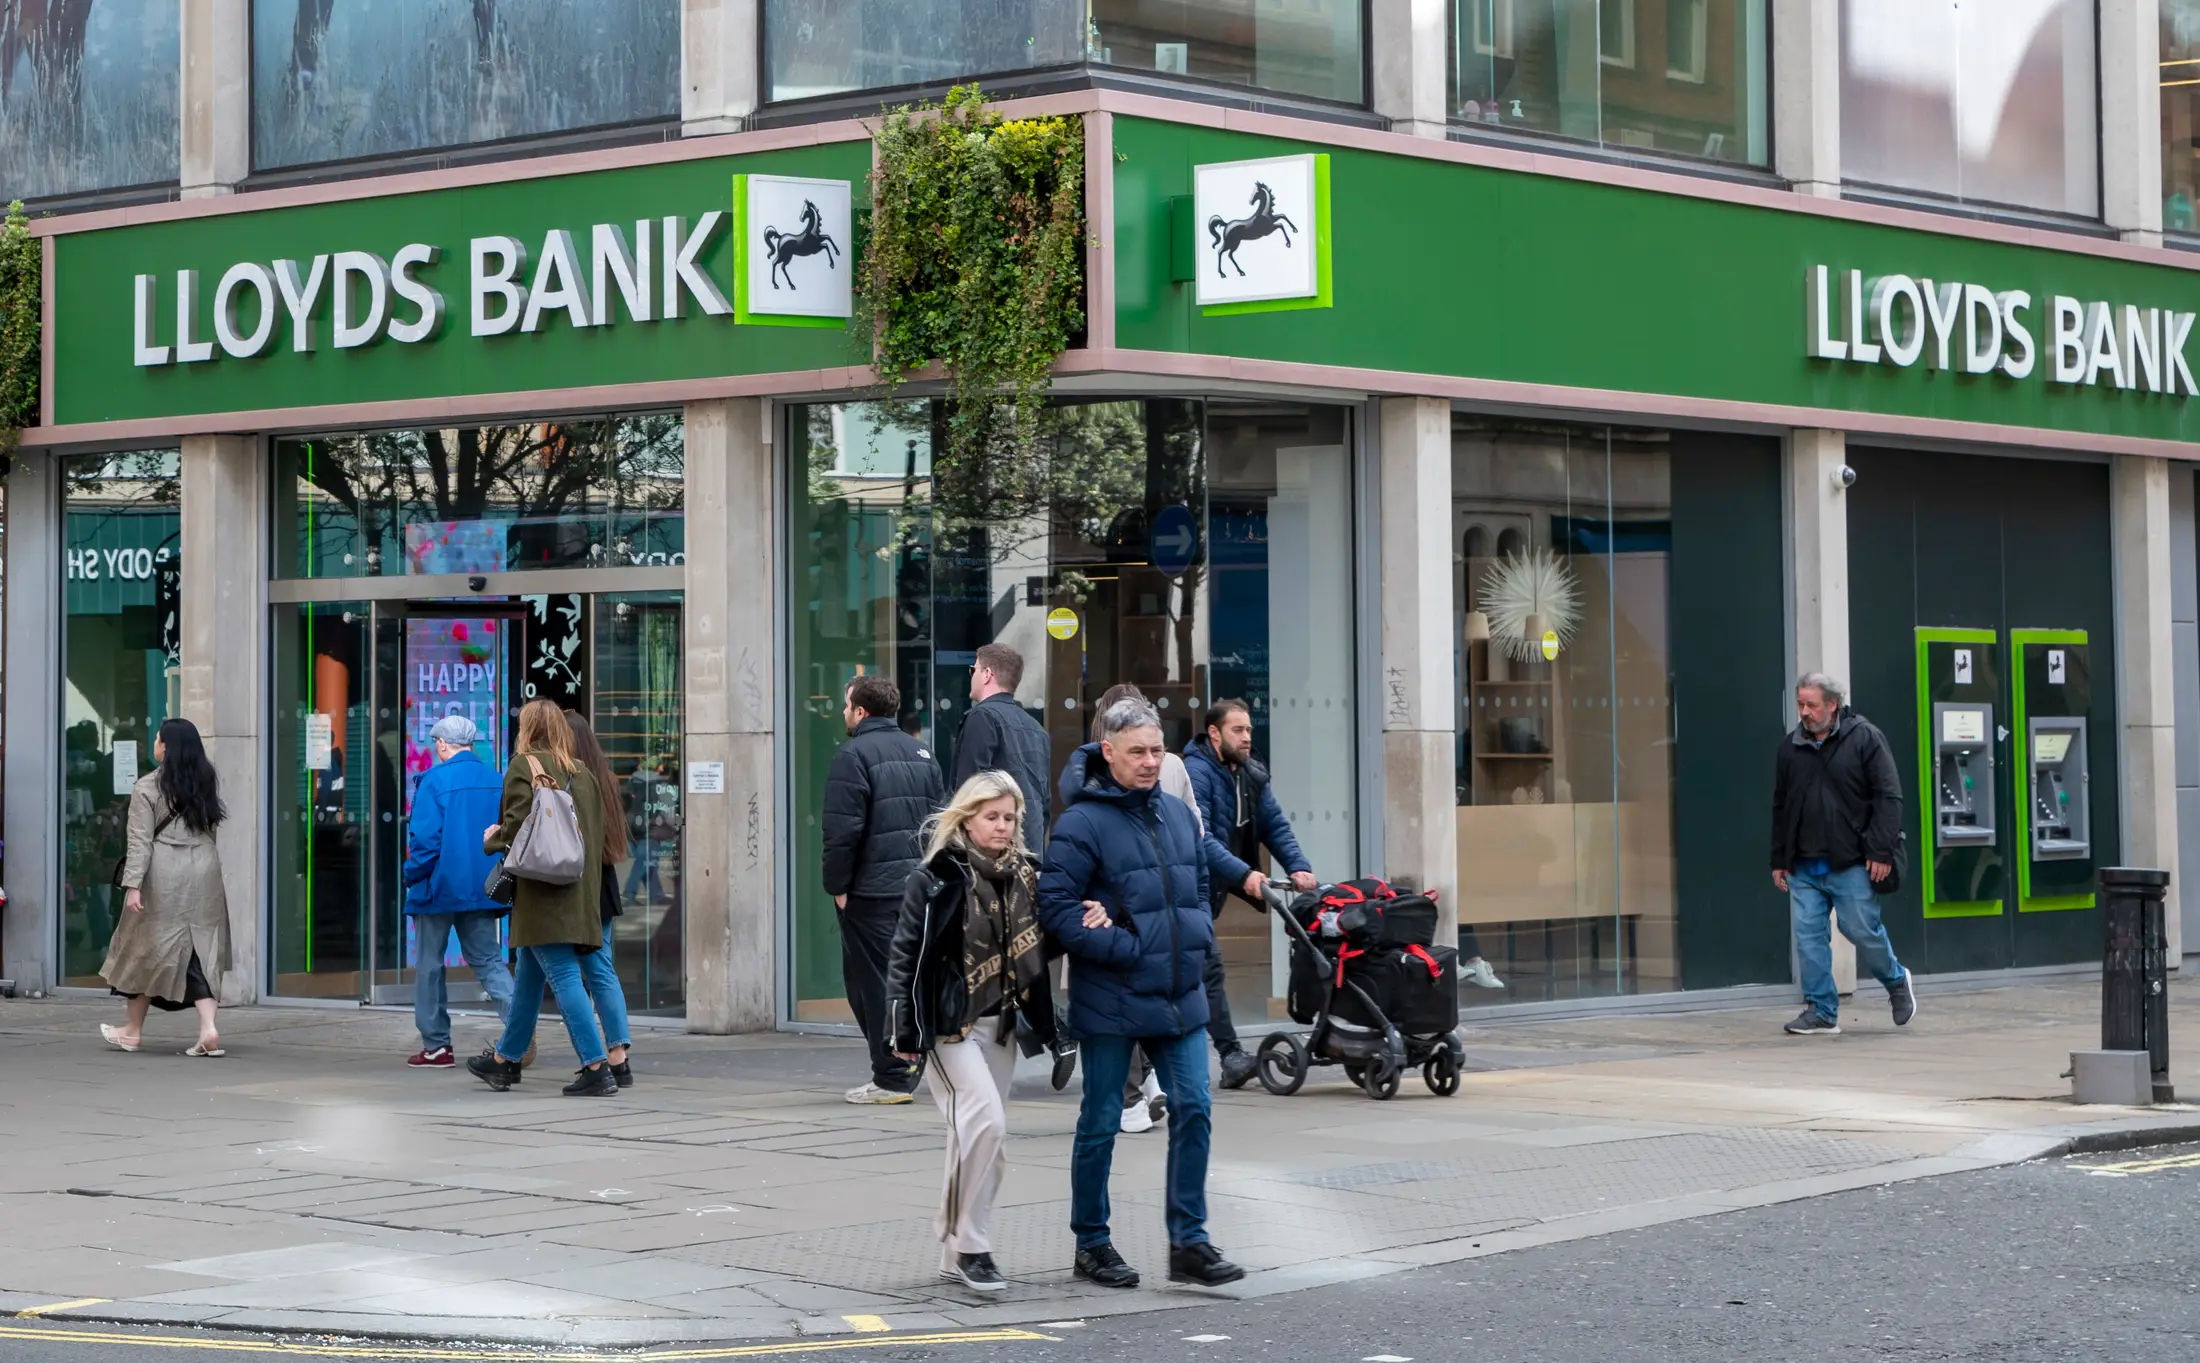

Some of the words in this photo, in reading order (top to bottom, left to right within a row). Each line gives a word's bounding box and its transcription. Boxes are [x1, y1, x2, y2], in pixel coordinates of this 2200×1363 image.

[134, 243, 446, 366] LLOYDS
[471, 211, 734, 337] BANK
[1807, 264, 2036, 380] LLOYDS
[2046, 295, 2199, 397] BANK
[418, 663, 496, 693] HAPPY
